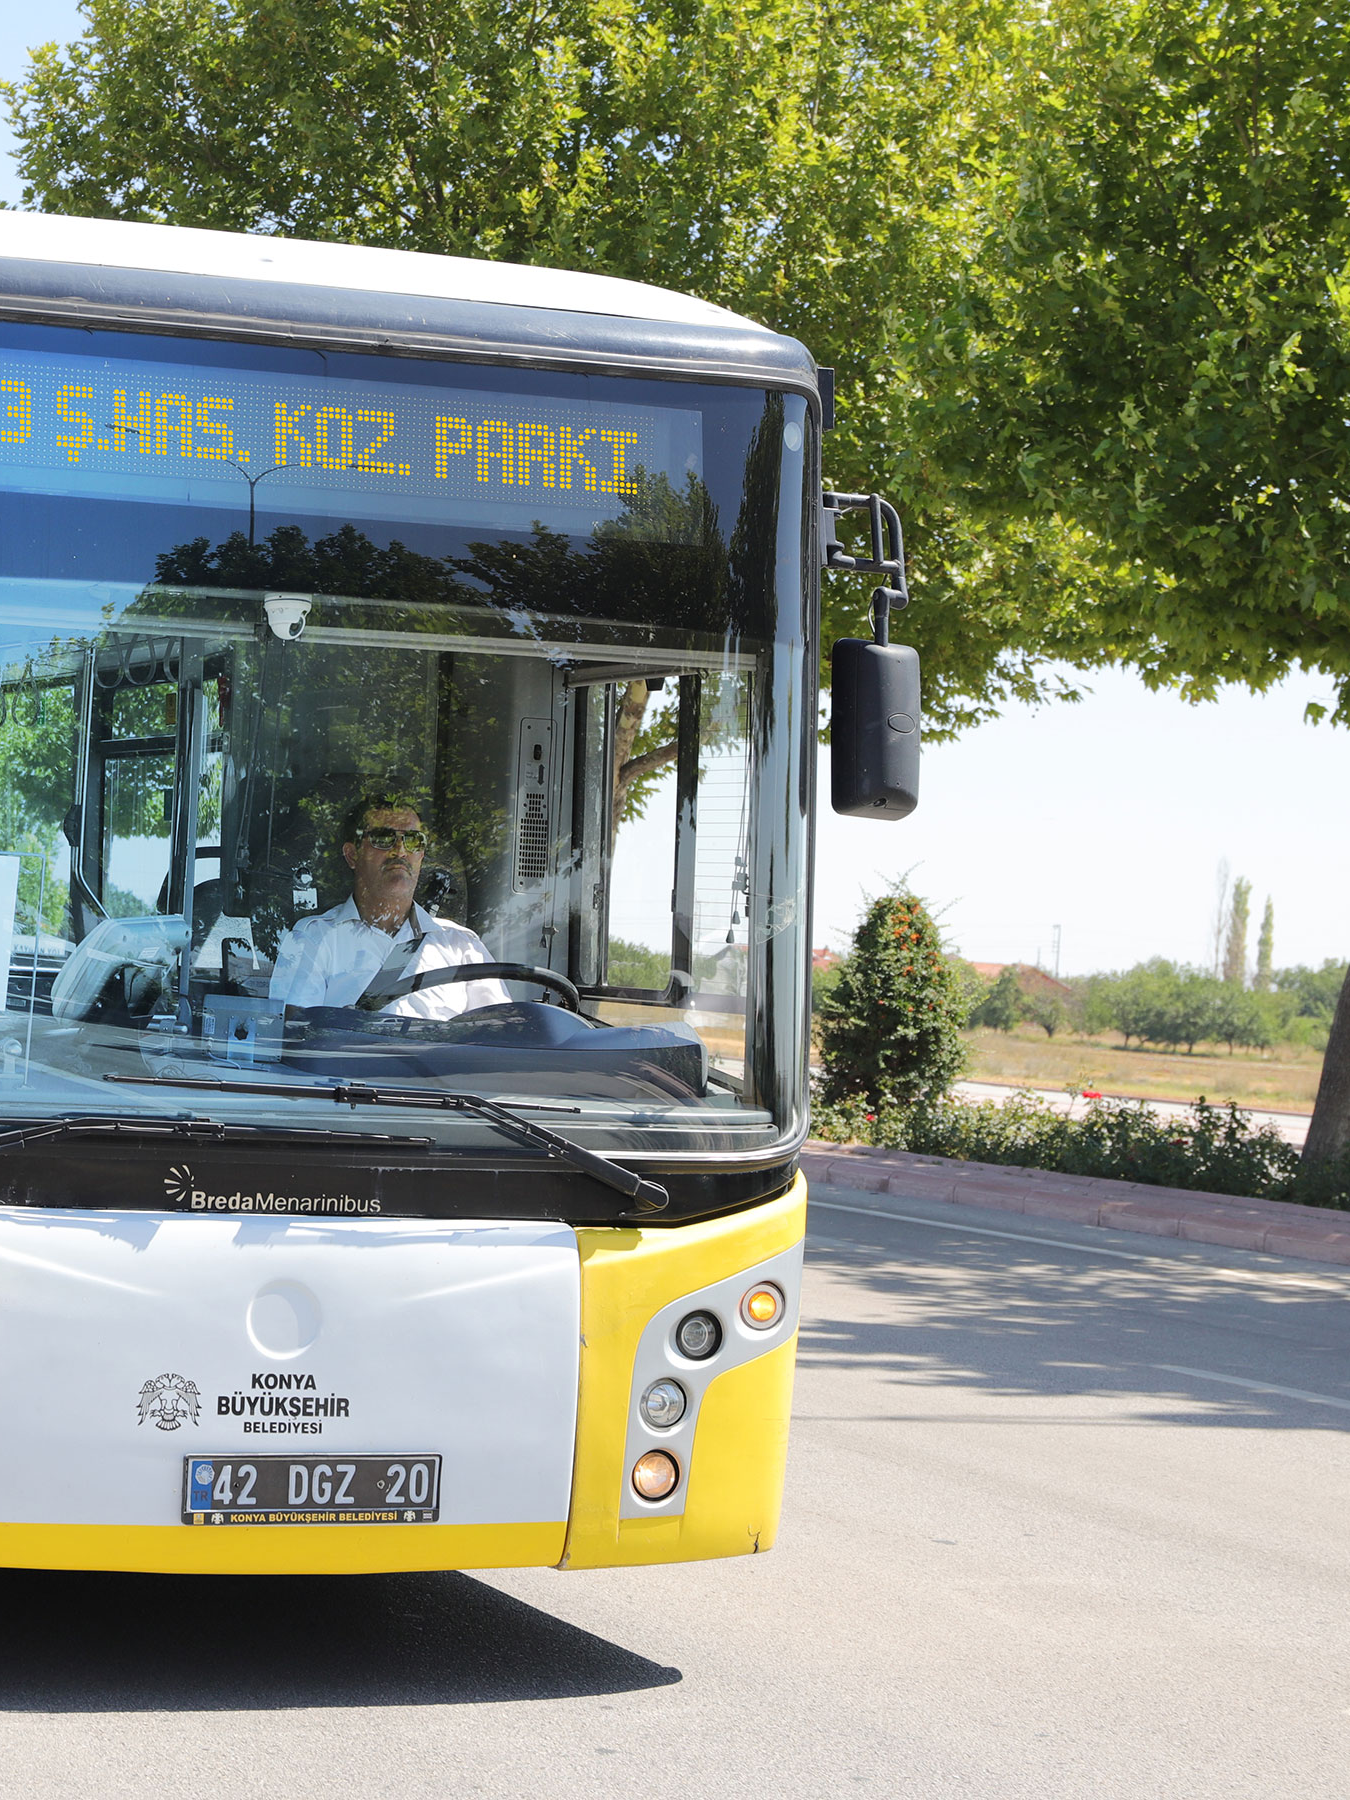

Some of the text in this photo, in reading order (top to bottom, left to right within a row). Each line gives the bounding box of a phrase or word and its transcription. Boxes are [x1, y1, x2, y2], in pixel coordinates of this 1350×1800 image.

[56, 384, 250, 462] Ş.HAS.
[275, 402, 410, 475] KOZ.
[435, 415, 638, 494] PARKI
[191, 1191, 381, 1213] BredaMenarinibus
[251, 1373, 316, 1390] KONYA
[217, 1392, 350, 1419] BÜYÜKŞEHİR
[243, 1419, 322, 1434] BELEDİYESİ
[213, 1463, 429, 1505] 42 DGZ 20
[193, 1490, 209, 1501] TR
[230, 1511, 398, 1523] KONYA BÜYÜKŞEHİR BELEDİYESİ
